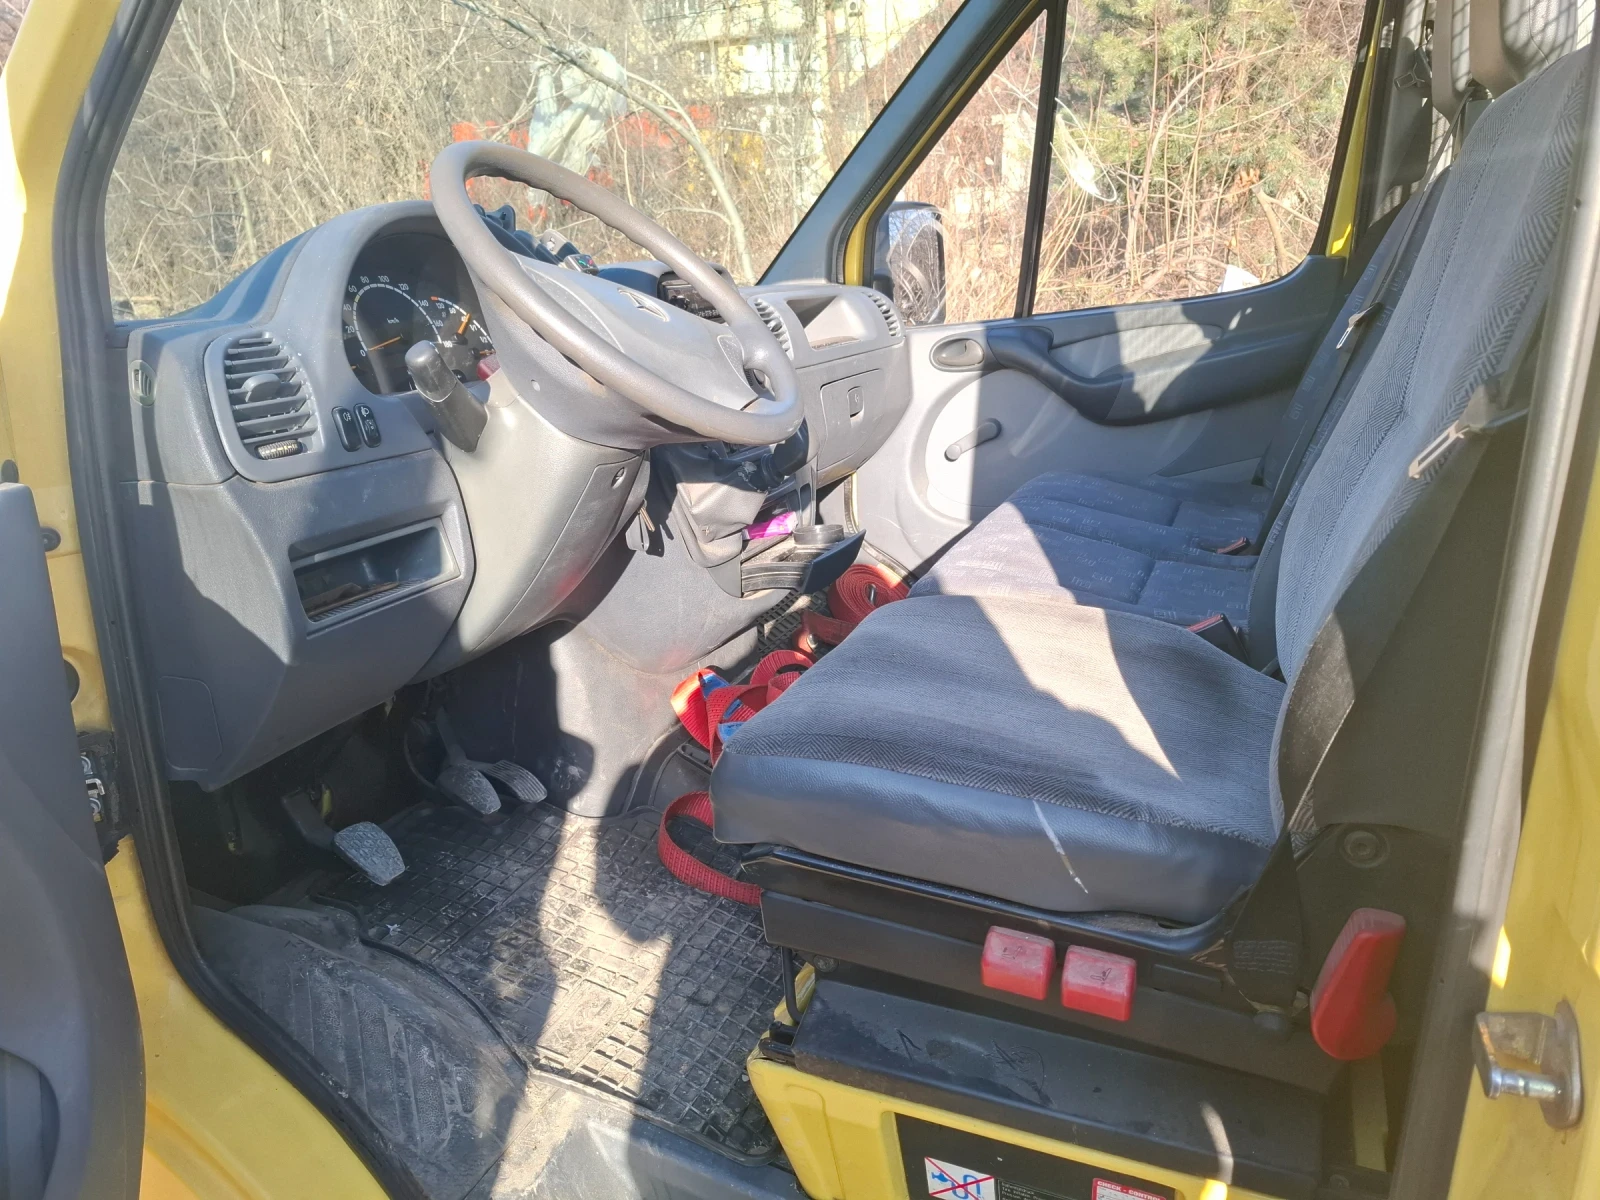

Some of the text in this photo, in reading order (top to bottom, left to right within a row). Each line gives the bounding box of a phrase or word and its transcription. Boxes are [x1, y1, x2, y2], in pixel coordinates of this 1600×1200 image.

[360, 275, 370, 284] 80
[378, 275, 390, 283] 100
[348, 285, 358, 293] 60
[398, 283, 410, 291] 120
[343, 303, 352, 311] 40
[418, 299, 429, 307] 140
[433, 319, 444, 327] 160
[345, 325, 355, 334] 20
[360, 349, 366, 357] 0
[1097, 1180, 1122, 1192] CHECK
